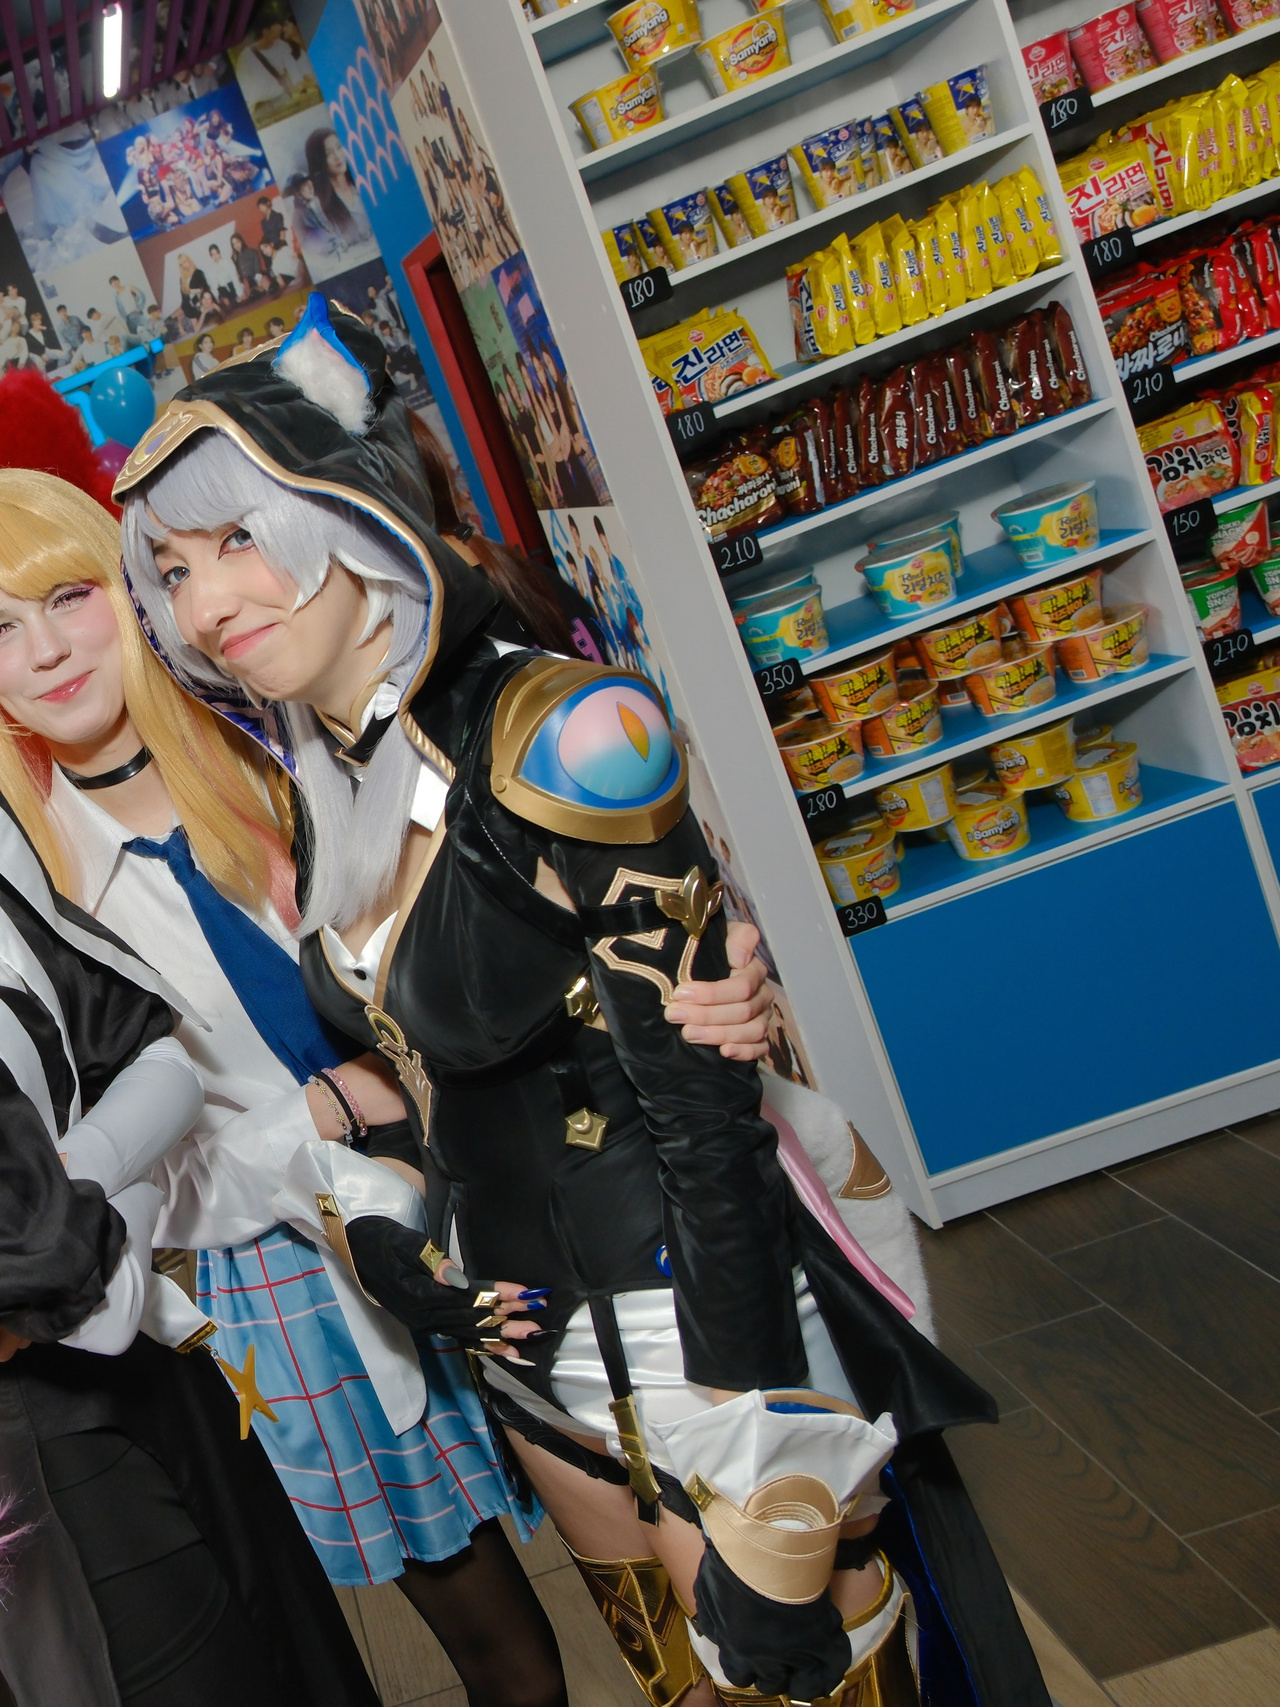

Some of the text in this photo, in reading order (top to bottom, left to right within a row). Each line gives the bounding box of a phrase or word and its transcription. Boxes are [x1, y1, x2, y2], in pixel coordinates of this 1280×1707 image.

[624, 9, 668, 47] Samyang
[729, 28, 778, 66] Samyang
[617, 85, 658, 115] Samyang
[1050, 98, 1078, 129] 180
[1067, 161, 1146, 216] 진라면
[1092, 237, 1122, 267] 180
[628, 275, 656, 308] 180
[671, 330, 744, 385] 진라면
[1042, 339, 1059, 389] Chacharoni
[1067, 331, 1086, 381] Chacharoni
[962, 368, 977, 419] Chacharoni
[992, 361, 1010, 411] Chacharoni
[1132, 372, 1163, 404] 210
[924, 393, 937, 444] Chacharoni
[942, 381, 957, 431] Chacharoni
[678, 411, 705, 440] 180
[868, 412, 879, 464] Chacharoni
[1172, 510, 1200, 536] 150
[720, 536, 757, 570] 210
[1213, 634, 1249, 667] 270
[761, 664, 795, 695] 350
[996, 755, 1027, 770] myang
[806, 790, 837, 819] 280
[973, 812, 1020, 841] Samyang
[845, 902, 877, 929] 330
